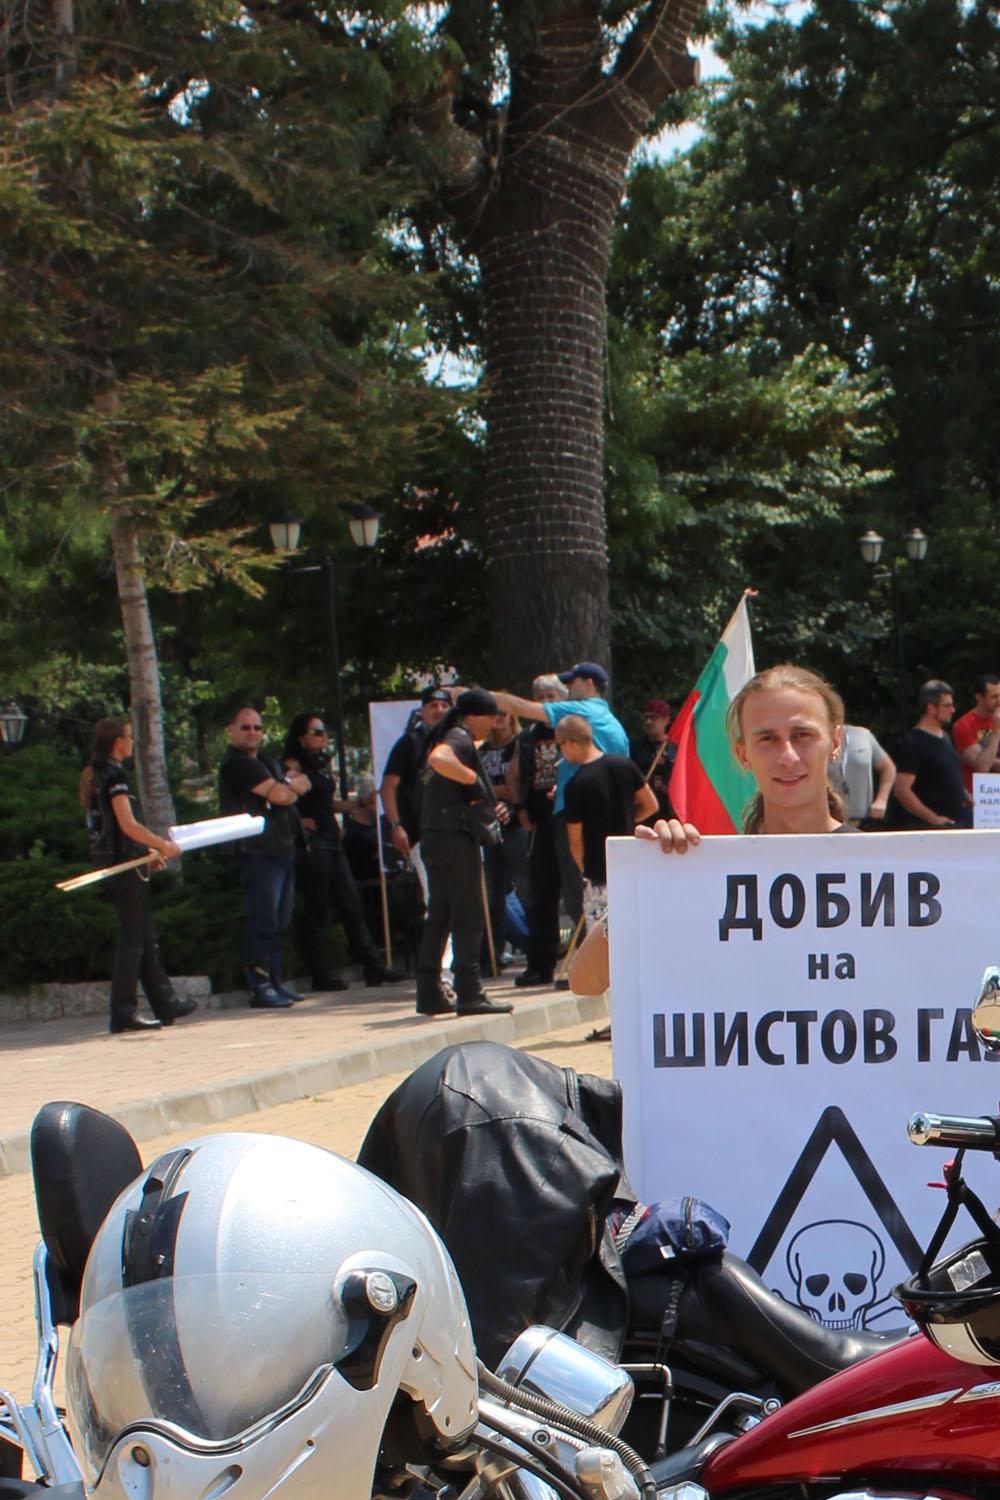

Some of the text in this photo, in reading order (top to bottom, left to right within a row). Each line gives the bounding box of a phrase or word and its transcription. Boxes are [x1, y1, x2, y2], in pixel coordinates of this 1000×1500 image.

[718, 872, 943, 941] ДОБИВ
[808, 950, 857, 980] на
[652, 1009, 899, 1068] ШИСТОВ
